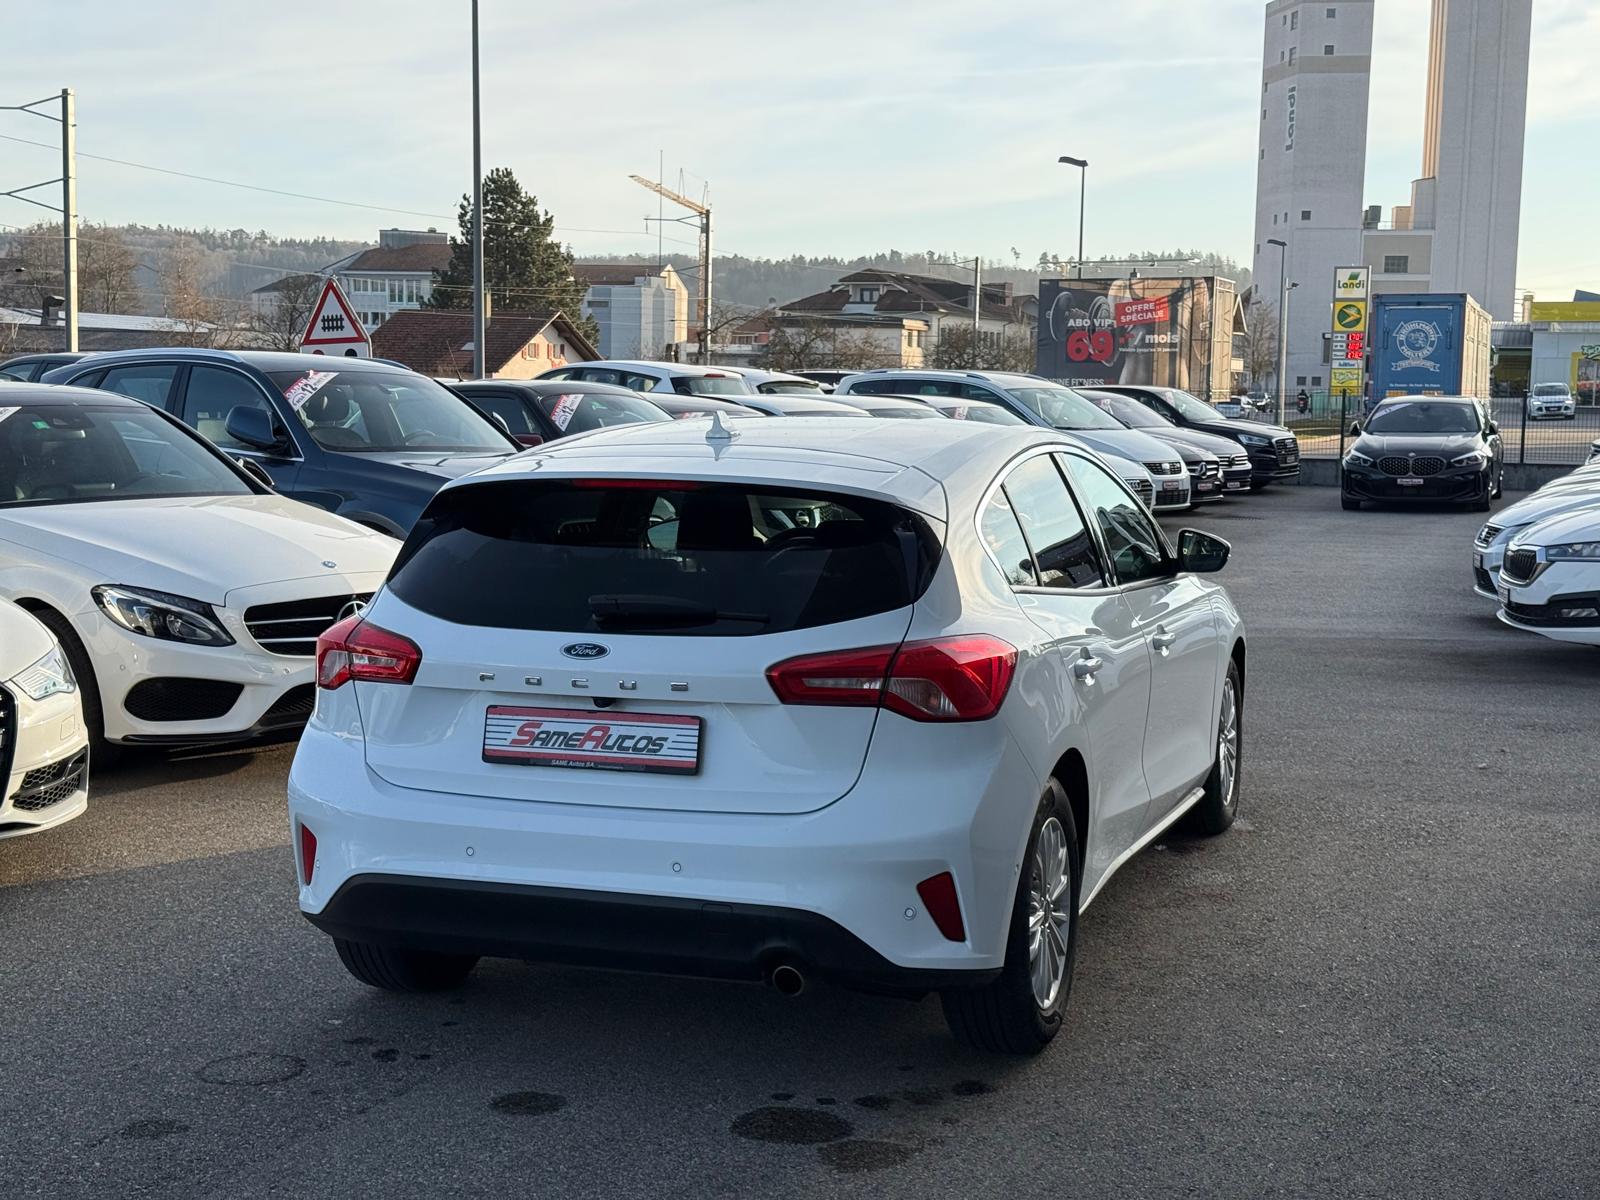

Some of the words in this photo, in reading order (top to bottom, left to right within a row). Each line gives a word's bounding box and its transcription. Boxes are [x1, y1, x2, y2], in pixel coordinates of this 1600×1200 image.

[1285, 86, 1297, 152] Landi
[1337, 279, 1365, 289] Landi
[1125, 302, 1156, 313] OFFRE
[1067, 318, 1091, 328] ABO
[1120, 310, 1164, 323] SPÉCIALE
[1067, 330, 1114, 361] 69
[570, 643, 600, 656] Ford
[479, 672, 689, 692] FOCUS
